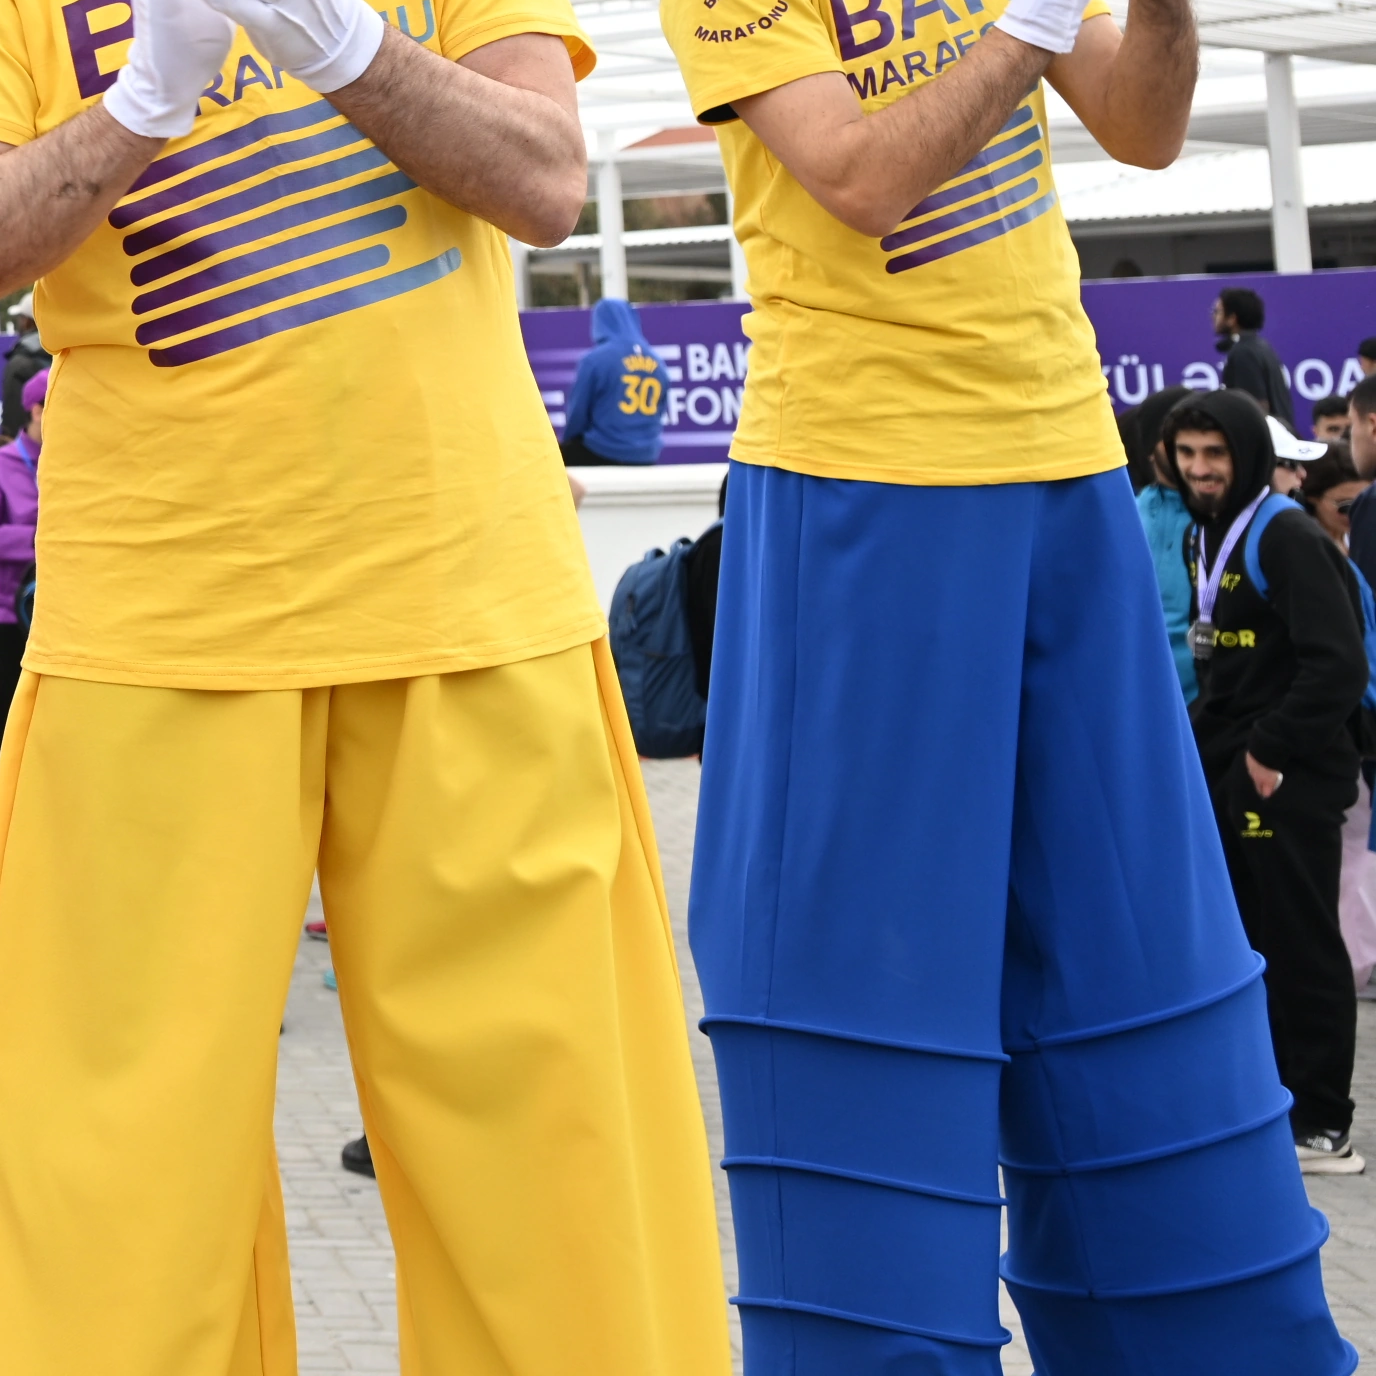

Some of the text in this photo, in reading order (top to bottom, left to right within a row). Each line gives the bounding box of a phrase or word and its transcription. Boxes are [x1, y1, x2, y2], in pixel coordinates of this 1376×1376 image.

[694, 0, 789, 43] MARAFONU
[686, 342, 752, 382] BAK
[618, 374, 662, 416] 30
